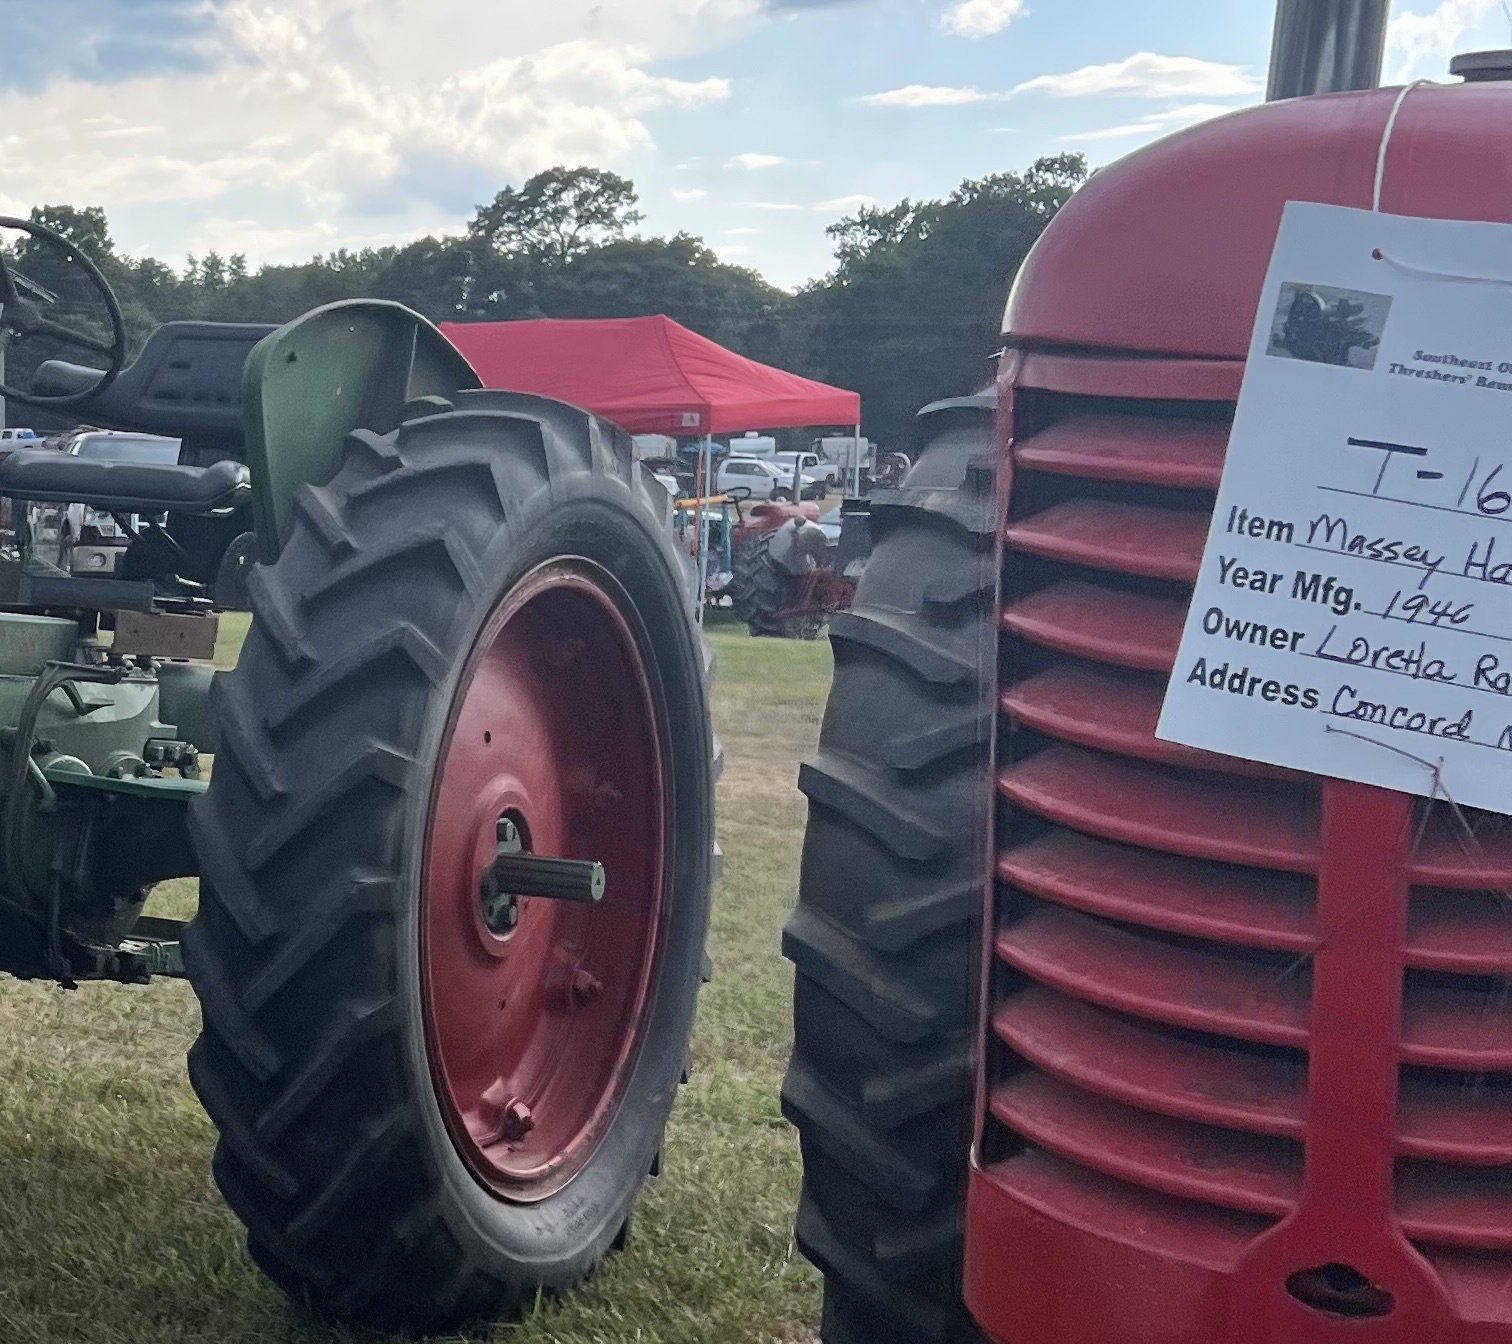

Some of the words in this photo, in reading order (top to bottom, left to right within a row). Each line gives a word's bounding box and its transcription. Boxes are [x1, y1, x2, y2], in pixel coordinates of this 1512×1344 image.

[1413, 350, 1493, 371] Southeast
[1226, 505, 1295, 544] Item
[1306, 513, 1446, 590] Massey
[1218, 555, 1284, 594] Year
[1291, 569, 1362, 616] Mfg.
[1381, 590, 1475, 626] 1946
[1202, 606, 1306, 653] Owner
[1315, 624, 1458, 680] Loretta
[1186, 657, 1321, 710] Address
[1332, 684, 1474, 741] Concord
